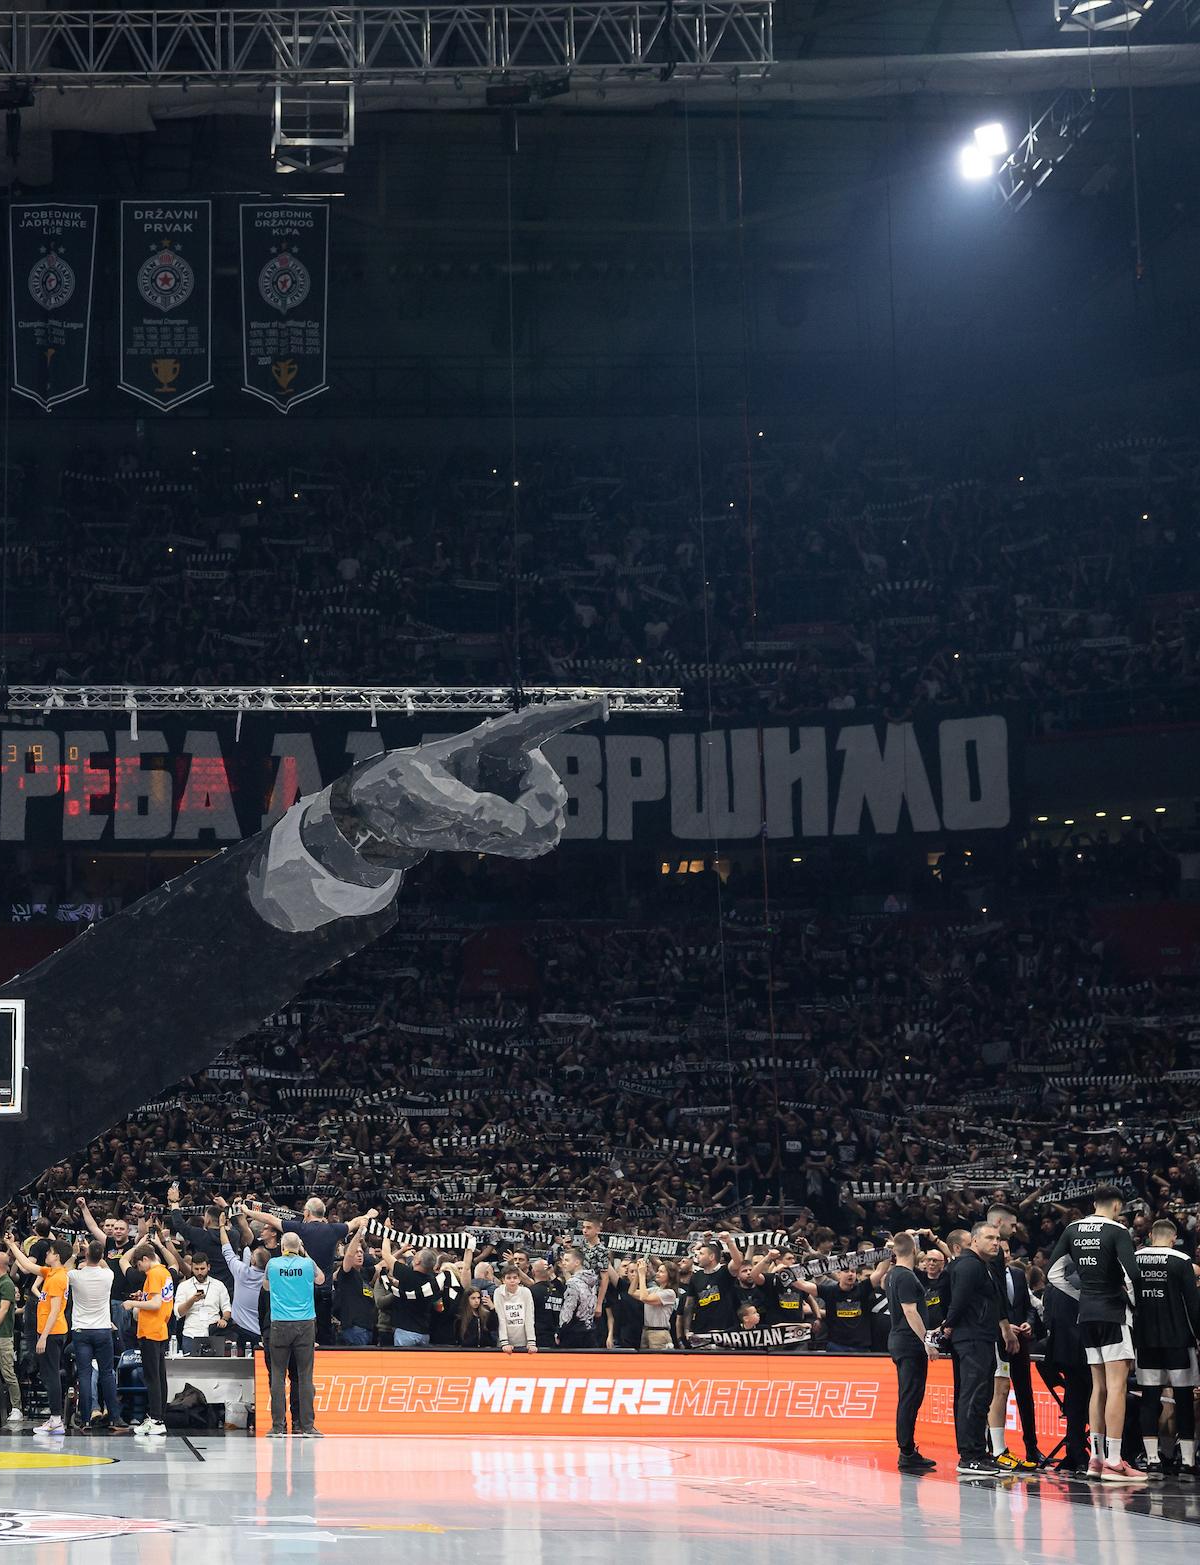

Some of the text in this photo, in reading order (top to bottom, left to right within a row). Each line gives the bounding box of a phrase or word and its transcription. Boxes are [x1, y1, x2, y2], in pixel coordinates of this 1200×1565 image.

[24, 211, 81, 220] POBEDNIK
[134, 208, 198, 220] DRŽAVNI
[257, 211, 312, 219] POBEDNIK
[19, 219, 87, 228] JADRANSKE
[143, 223, 193, 233] PRVAK
[255, 218, 314, 228] DRŽAVNOG
[608, 1236, 678, 1255] ПАРТИЗАН
[1079, 1256, 1098, 1266] mts
[279, 1268, 303, 1277] PHOTO
[1141, 1270, 1168, 1278] LOBOS
[1141, 1287, 1165, 1298] mts
[712, 1326, 782, 1349] PARTIZAN
[313, 1376, 879, 1419] ATTERS MATTERS MATTERS
